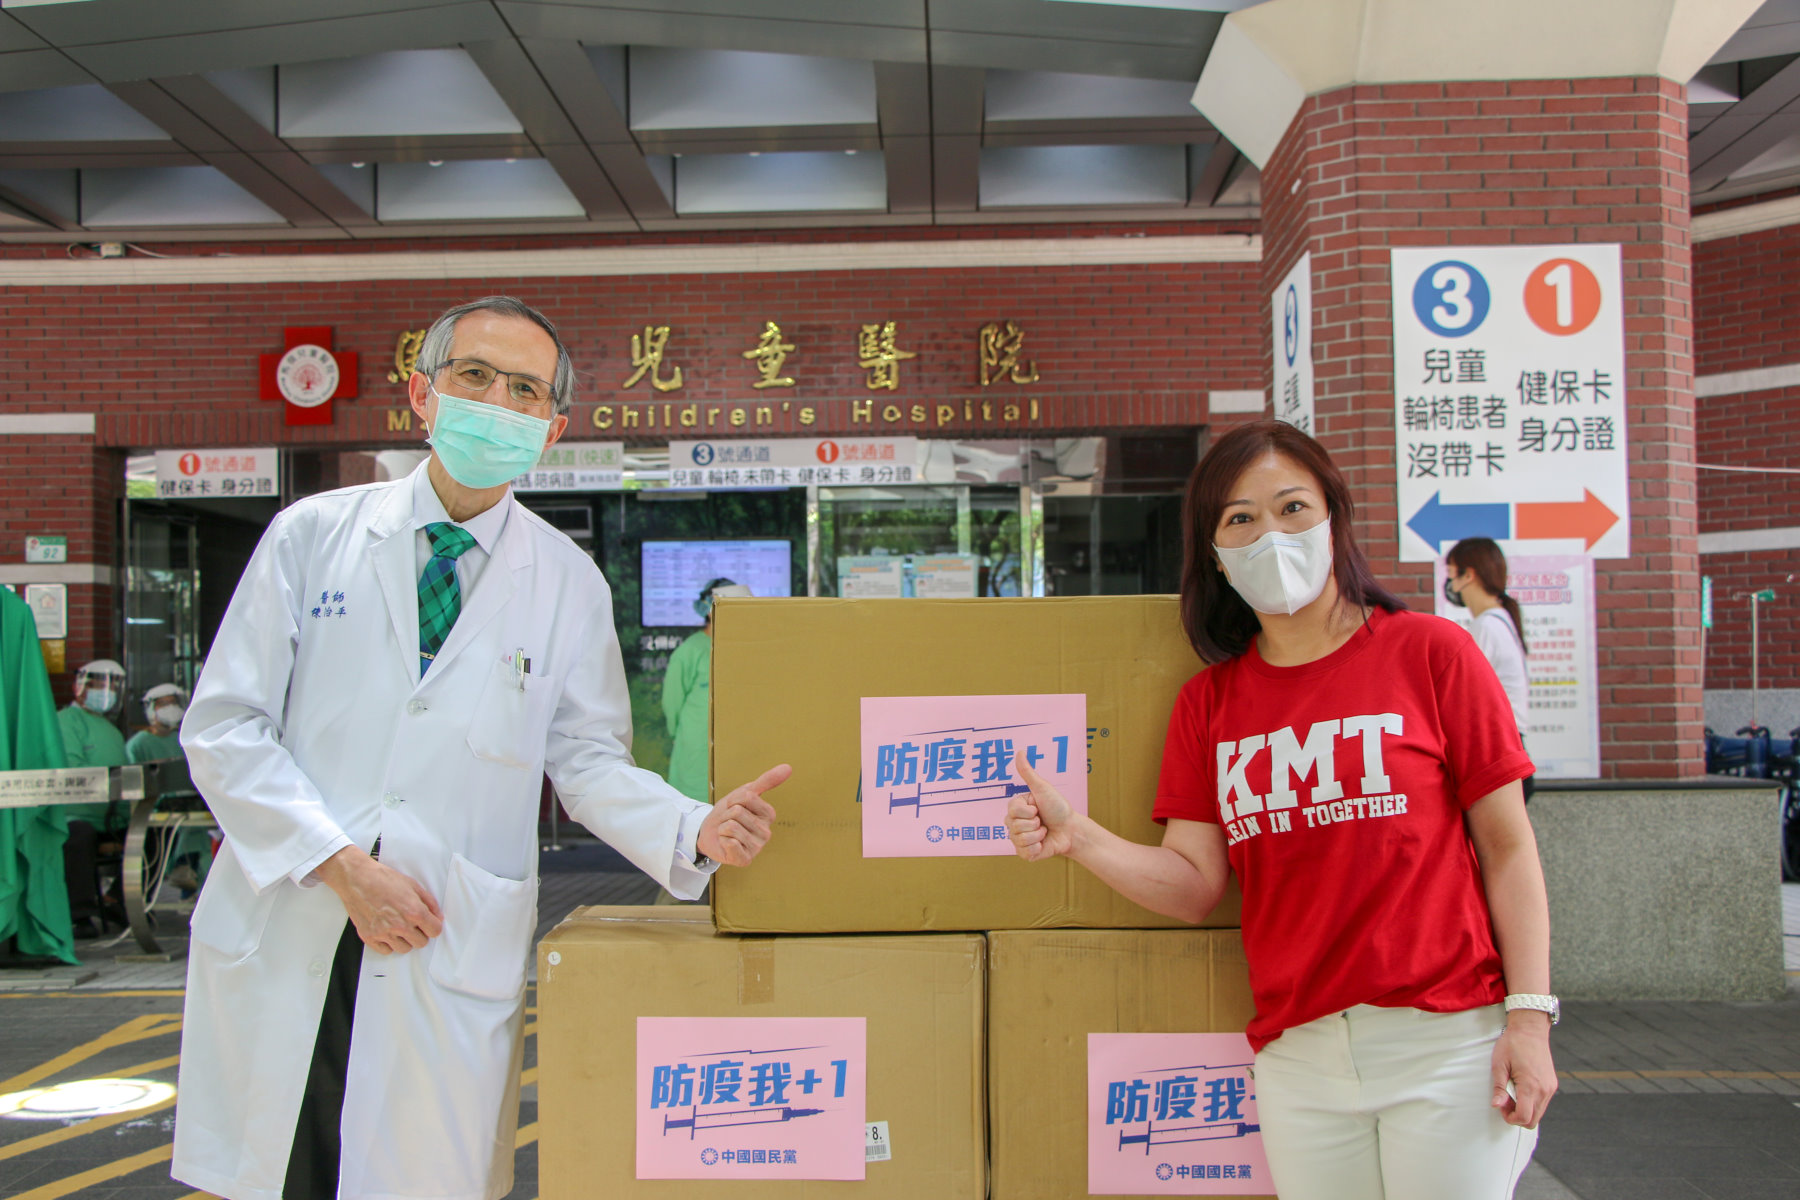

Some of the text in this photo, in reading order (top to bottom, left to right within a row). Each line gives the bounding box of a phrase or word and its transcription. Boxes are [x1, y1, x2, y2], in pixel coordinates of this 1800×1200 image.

[1432, 266, 1474, 330] 3
[1543, 263, 1573, 327] 1
[1422, 348, 1487, 384] 兒童
[1516, 368, 1612, 405] 健保卡
[593, 399, 1039, 429] Children's Hospital
[1403, 394, 1507, 431] 輪椅患者
[1518, 416, 1615, 452] 身分證
[1407, 442, 1505, 478] 沒帶卡
[1217, 712, 1403, 824] KMT
[1268, 811, 1292, 834] IN
[1303, 793, 1408, 828] TOGETHER
[946, 825, 1014, 841] 中國國民
[1106, 1075, 1256, 1125] 防疫我
[721, 1149, 798, 1164] 中國國民黨
[1176, 1164, 1253, 1179] 中國國民黨
